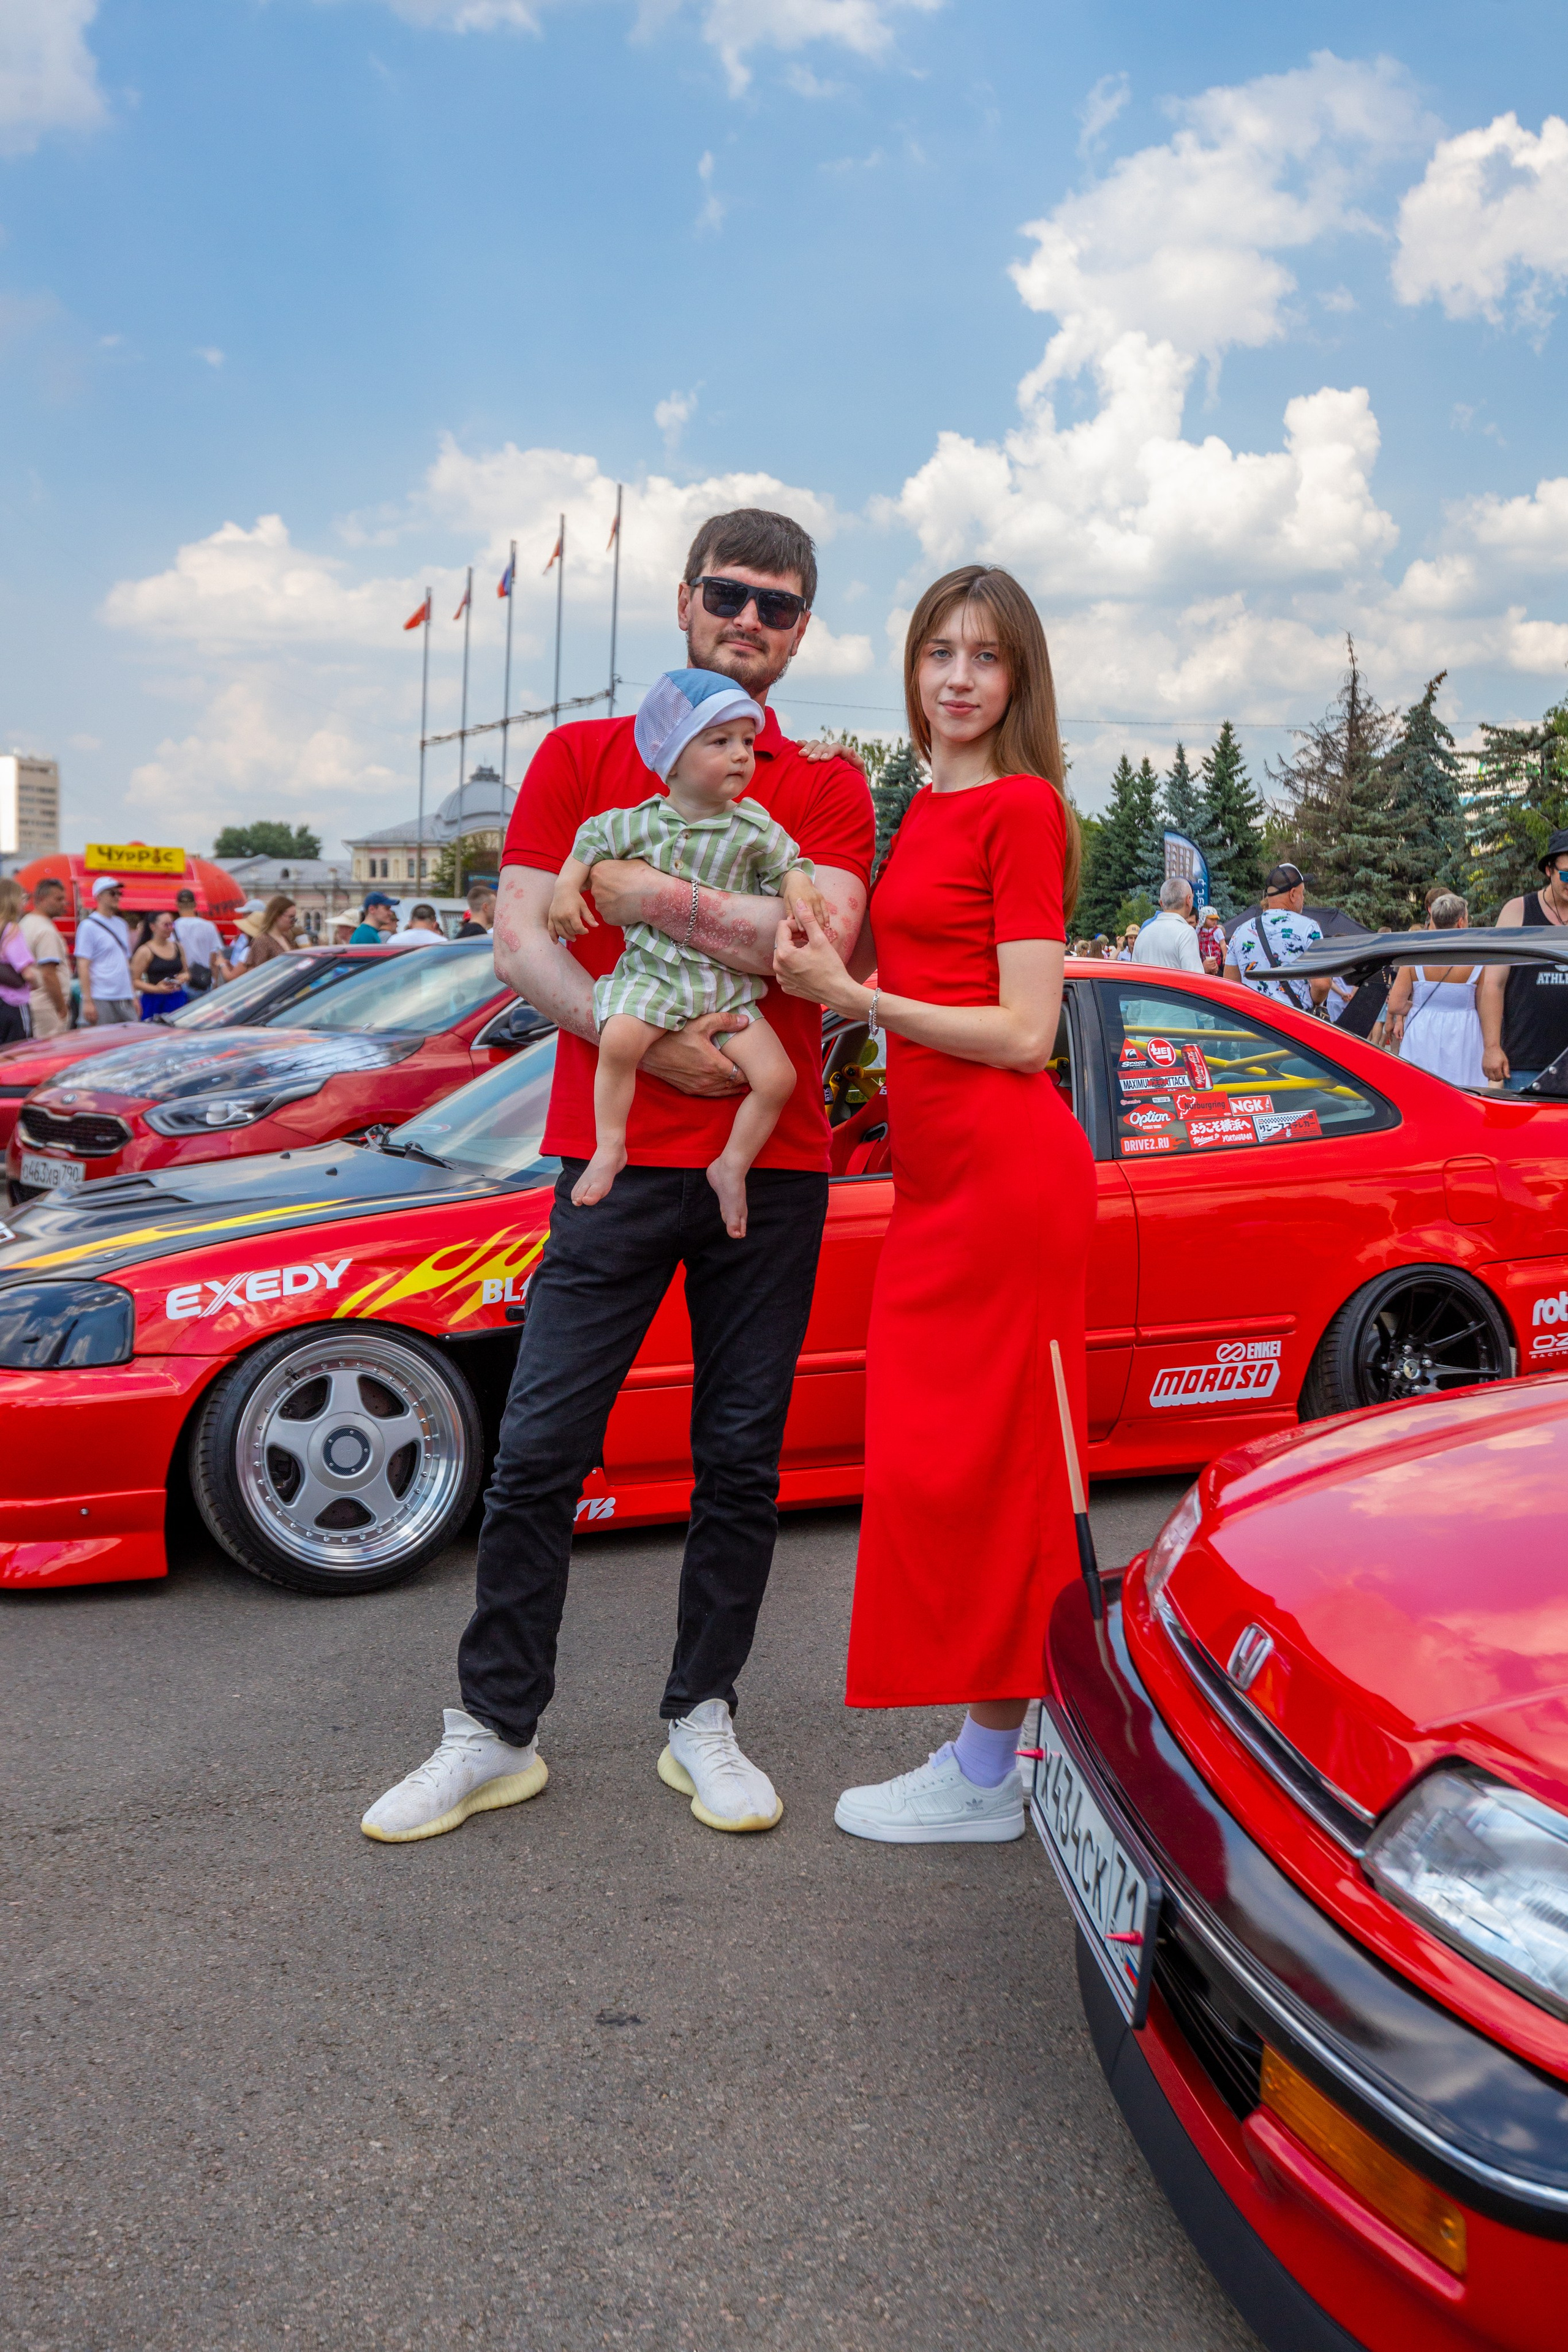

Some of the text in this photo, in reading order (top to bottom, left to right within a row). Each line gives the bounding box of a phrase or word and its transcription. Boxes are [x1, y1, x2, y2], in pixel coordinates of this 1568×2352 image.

[1231, 1099, 1264, 1113] NGK
[1129, 1110, 1171, 1127] Option
[1190, 1118, 1251, 1136] ようこそ横浜へ
[1124, 1137, 1170, 1152] DRIVE2.RU
[1193, 1135, 1213, 1145] Welcome
[1222, 1133, 1253, 1142] YOKOHAMA
[166, 1258, 353, 1320] EXEDY
[1246, 1340, 1282, 1360] ENKEI
[1153, 1363, 1275, 1398] MOROSO
